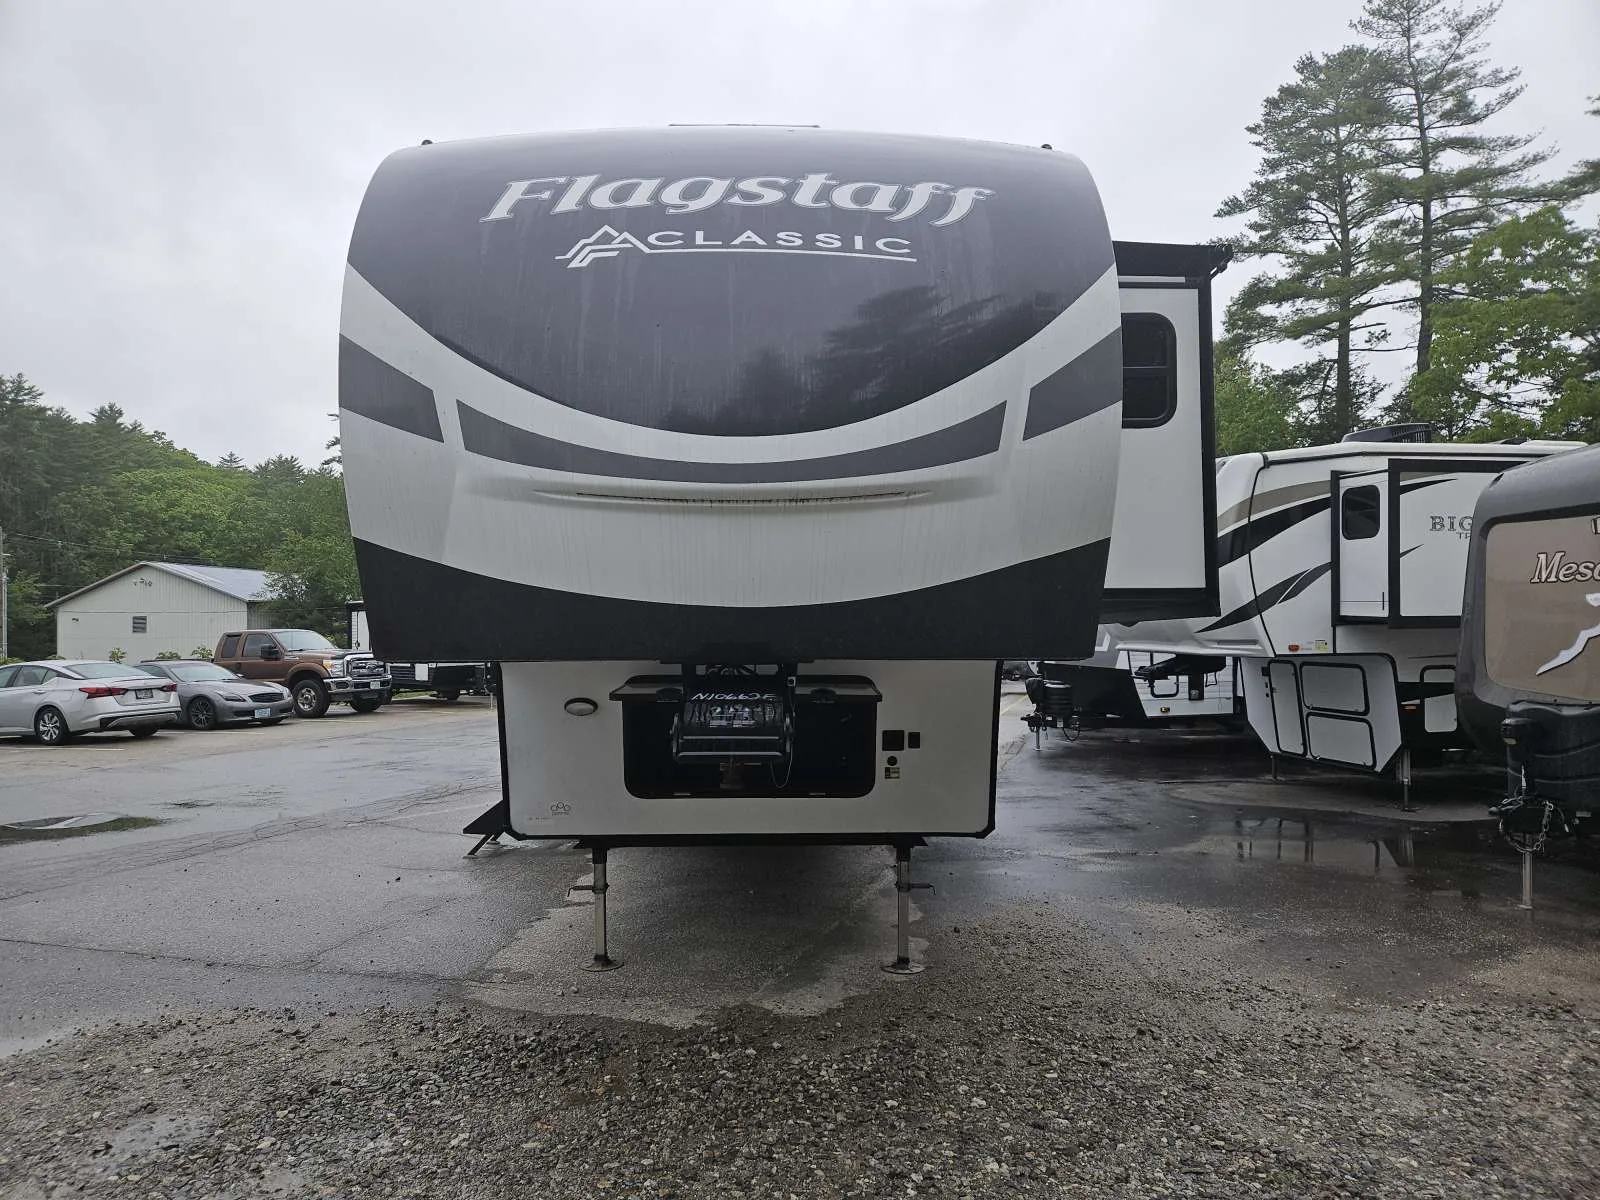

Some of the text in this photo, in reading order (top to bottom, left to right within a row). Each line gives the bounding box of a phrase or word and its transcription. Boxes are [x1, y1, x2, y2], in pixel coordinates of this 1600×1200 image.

[479, 172, 996, 227] Flagstaff
[646, 230, 912, 253] CLASSIC
[1430, 515, 1473, 532] BIG
